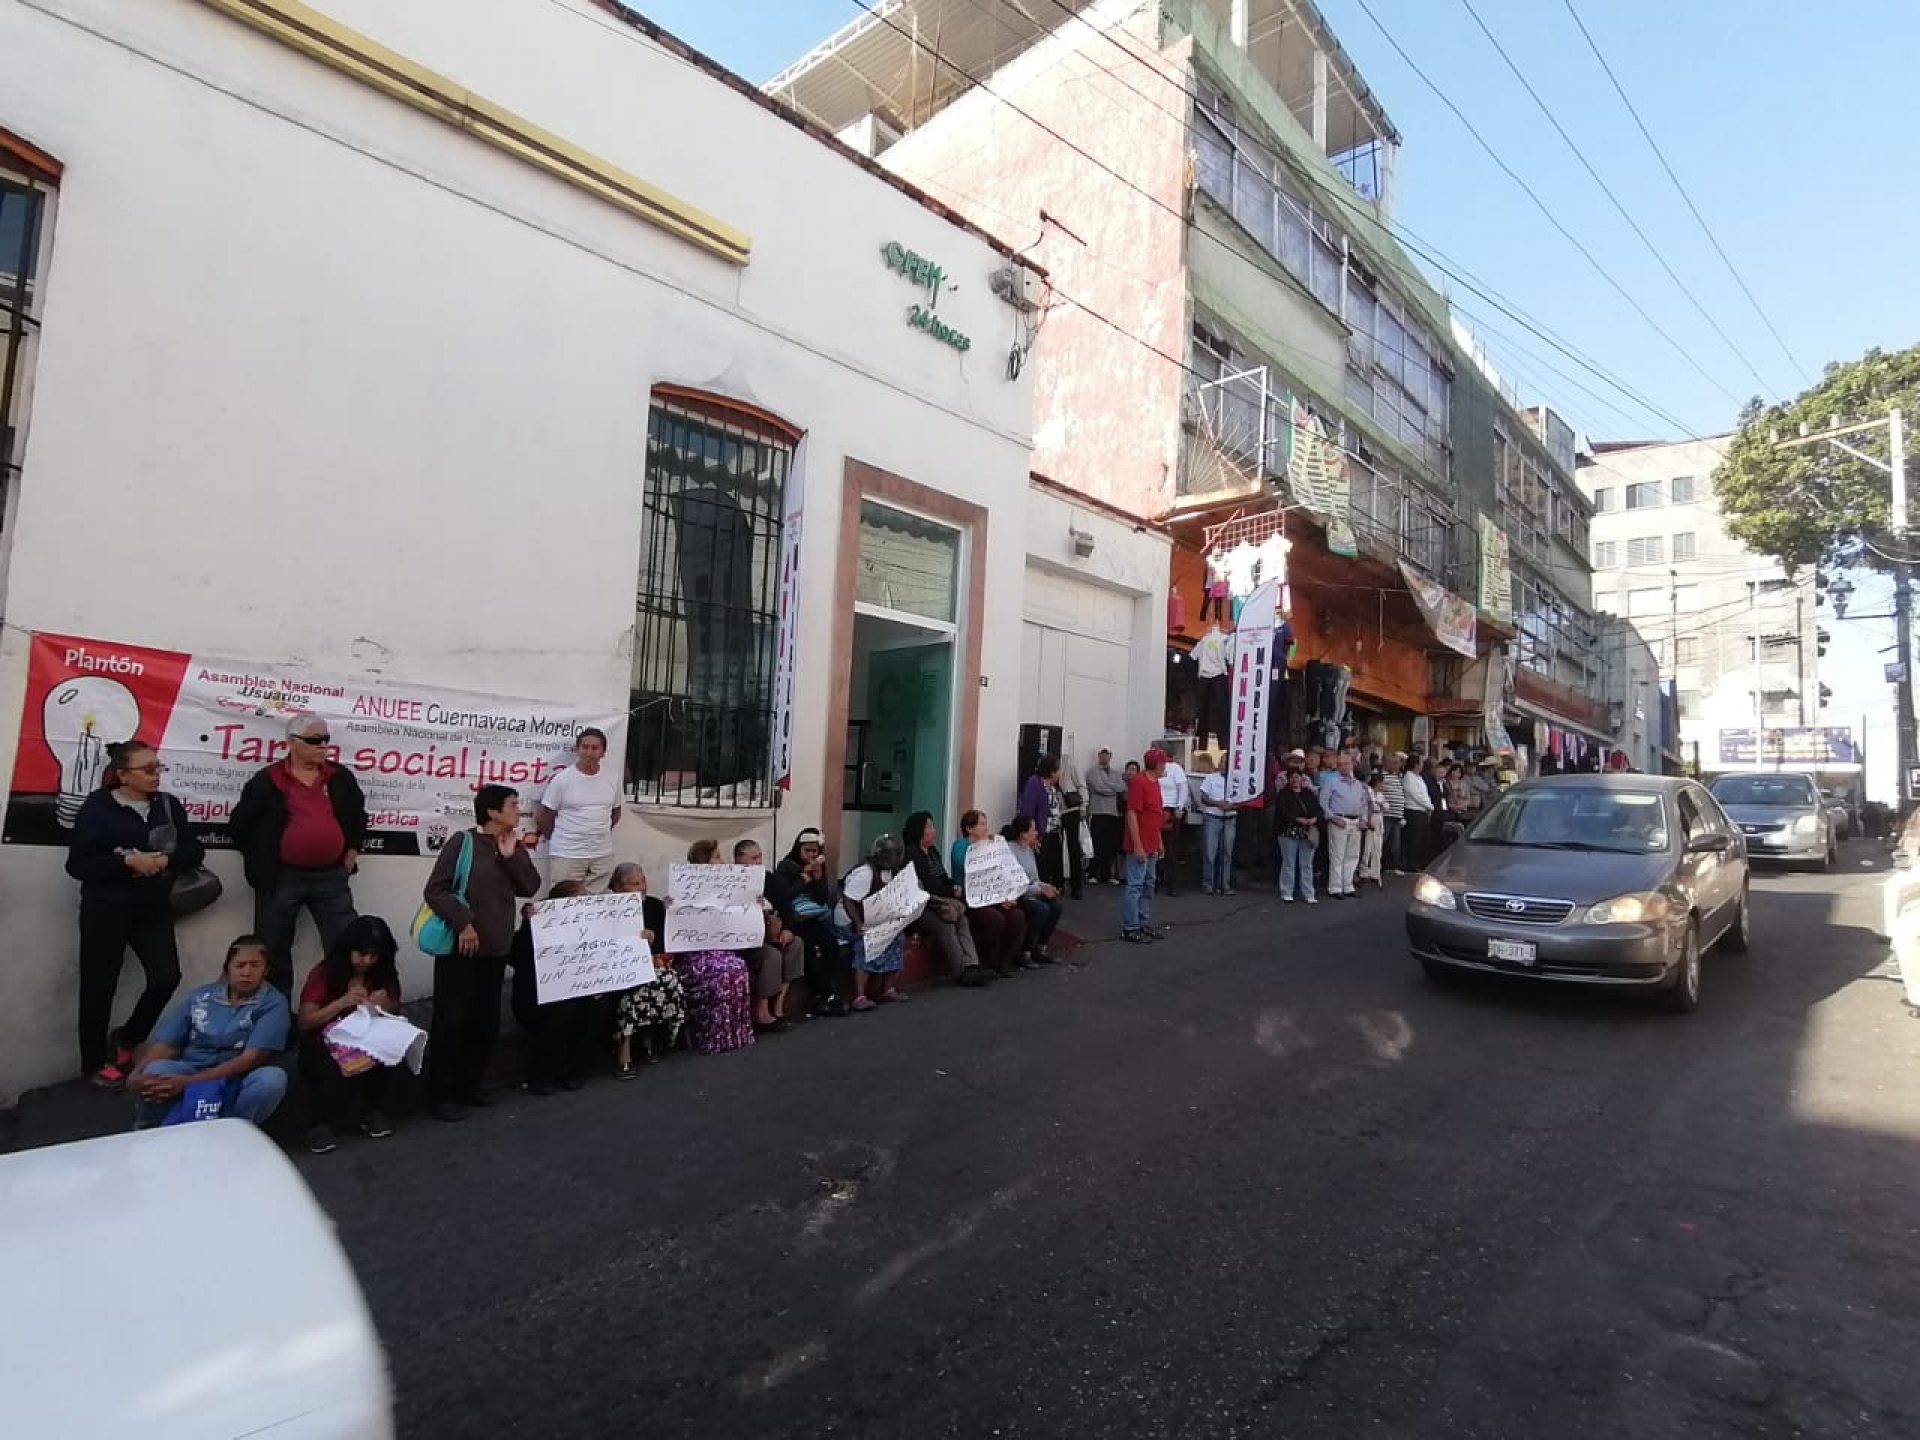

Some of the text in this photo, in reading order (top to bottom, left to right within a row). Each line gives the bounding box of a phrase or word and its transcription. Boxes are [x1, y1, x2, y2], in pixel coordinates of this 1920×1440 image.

[64, 647, 144, 676] Plantón
[198, 669, 344, 698] Asamblea Nacional
[241, 686, 310, 704] Usuarios
[353, 694, 585, 739] ANUEE Cuernavaca Morelo
[1234, 652, 1248, 770] ANUEE
[1248, 647, 1265, 796] MORELOS
[346, 721, 400, 737] Asamblea
[403, 726, 447, 742] Nacional
[450, 732, 463, 743] de
[214, 723, 342, 763] Tara
[353, 745, 469, 780] social
[366, 808, 420, 827] gética
[539, 968, 566, 985] UN
[569, 971, 637, 992] HUMANO
